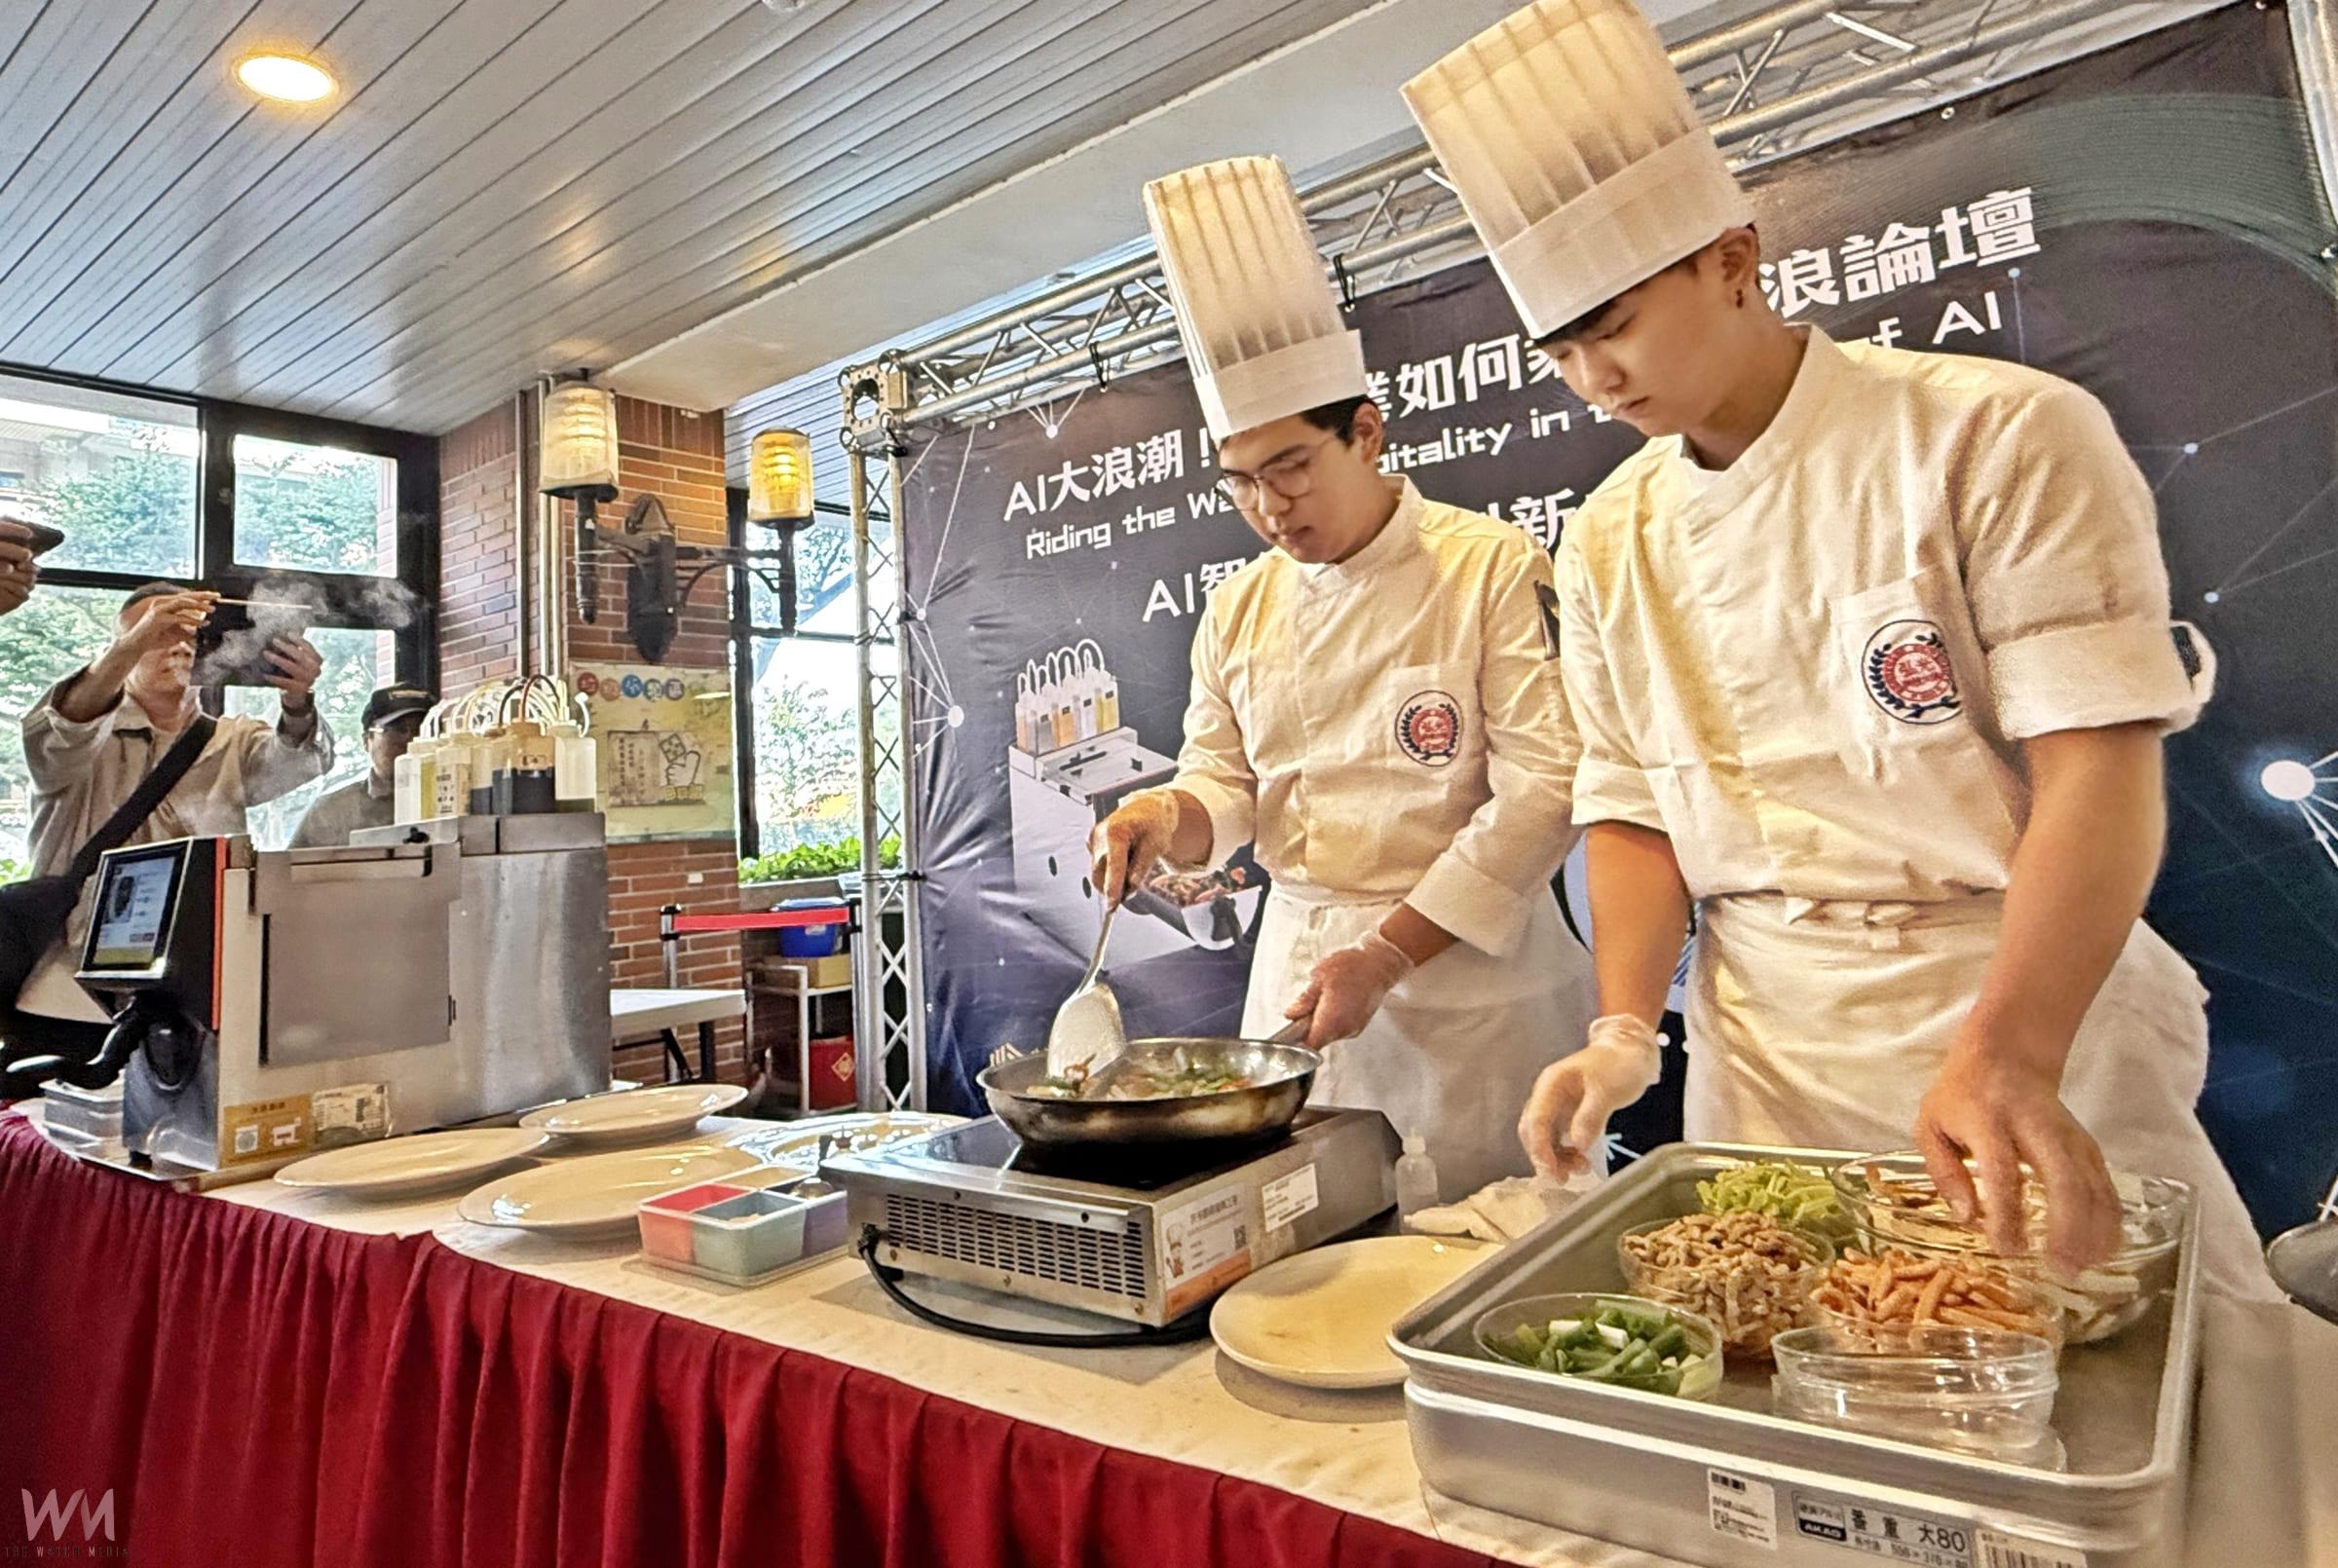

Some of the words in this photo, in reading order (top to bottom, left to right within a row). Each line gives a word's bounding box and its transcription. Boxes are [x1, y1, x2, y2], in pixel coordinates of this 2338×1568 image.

[1758, 187, 2041, 319] 浪論壇
[1027, 522, 1112, 560] Riding
[1122, 505, 1176, 535] the
[1529, 407, 1570, 438] in
[1932, 291, 2003, 345] AI
